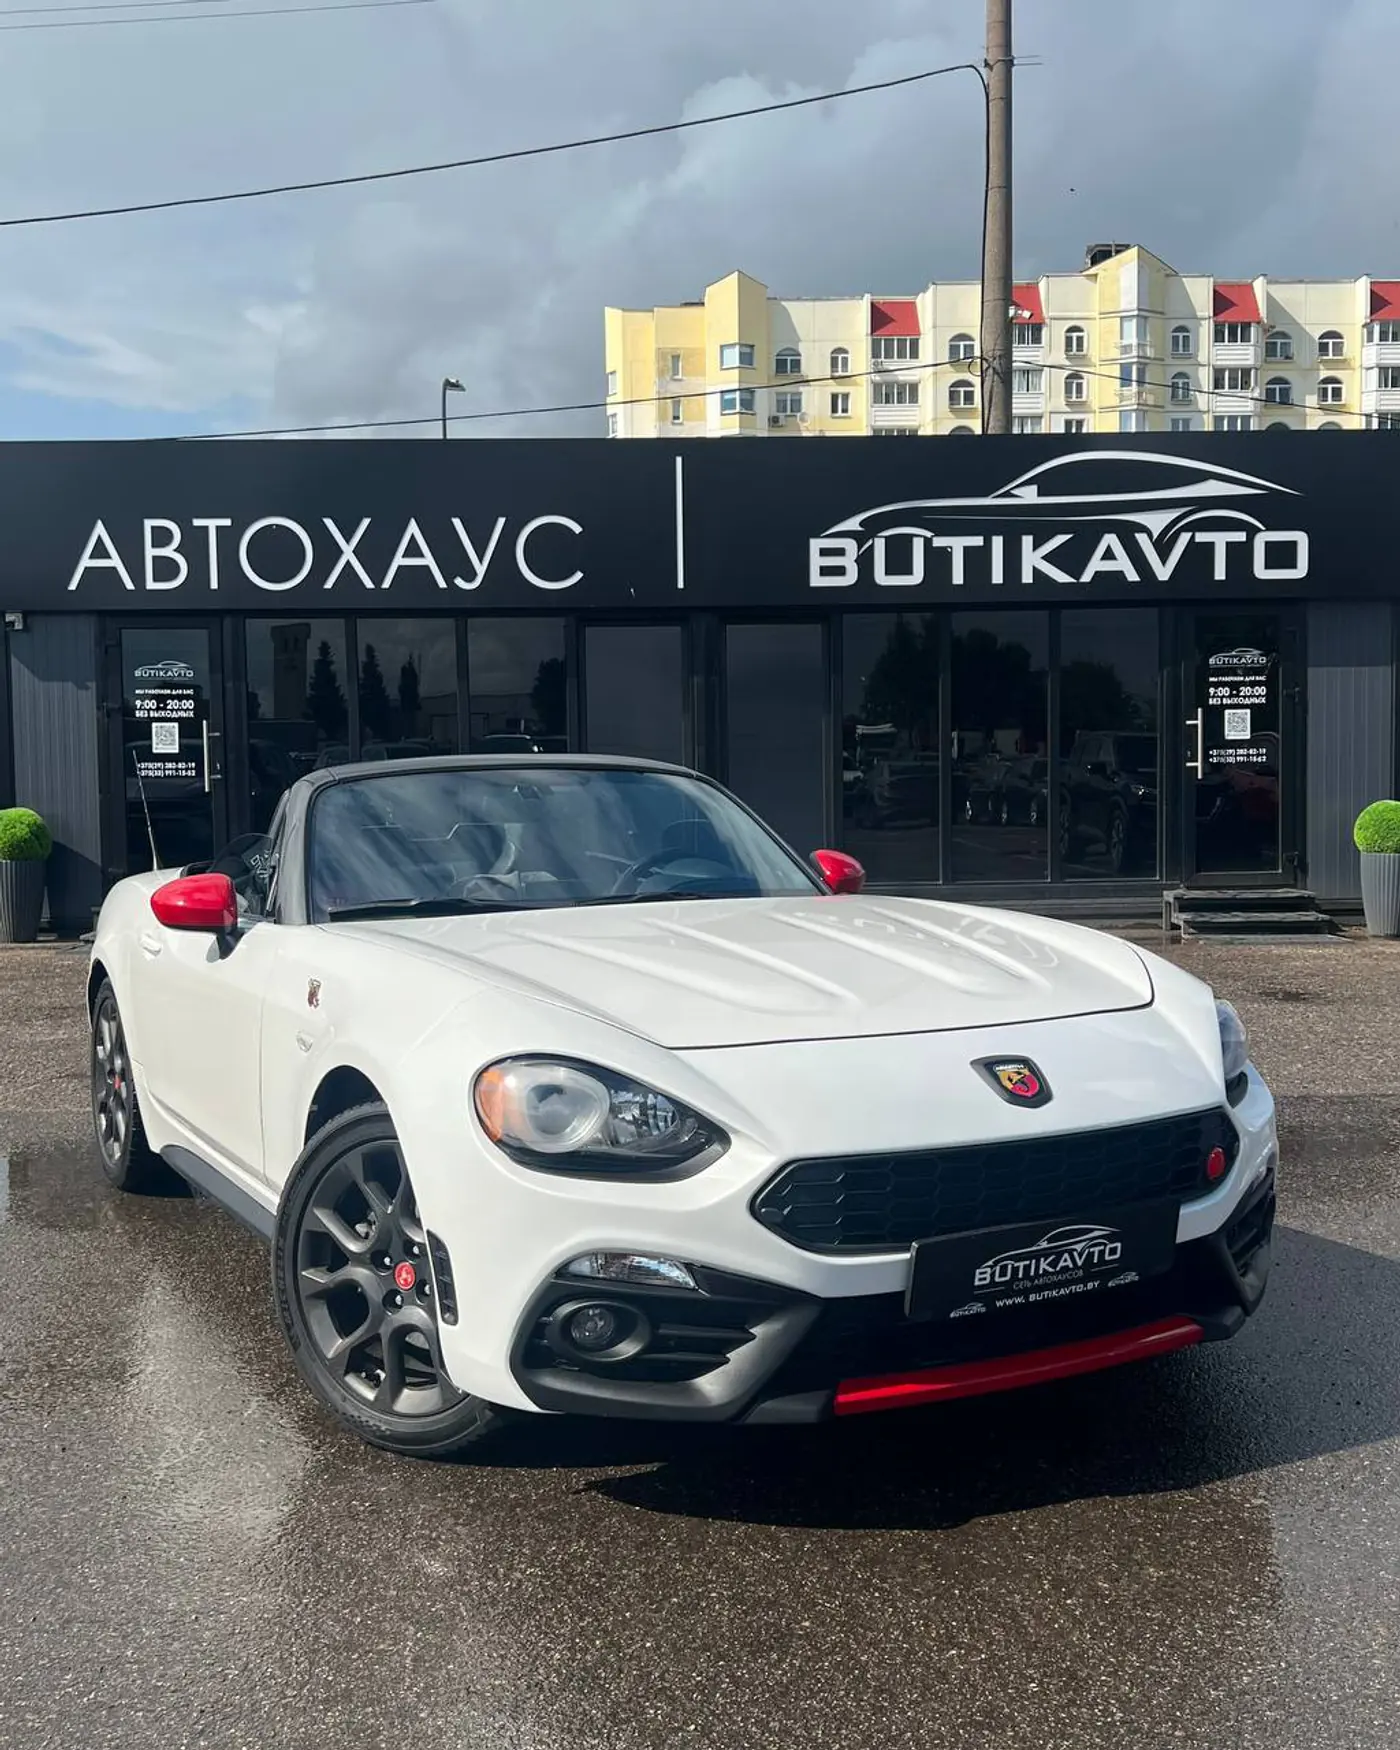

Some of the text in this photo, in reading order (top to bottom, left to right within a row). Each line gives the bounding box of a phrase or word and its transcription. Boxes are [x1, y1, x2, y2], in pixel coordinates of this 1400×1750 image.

[67, 515, 585, 591] АВТОХАУС
[808, 530, 1310, 588] BUTIKAVTO
[1209, 656, 1267, 665] BUTIKAVTO
[134, 669, 194, 678] BUTIKAVTO
[1209, 687, 1230, 696] 9:00
[1239, 686, 1267, 696] 20:00
[135, 699, 157, 709] 9:00
[166, 699, 194, 709] 20:00
[1209, 696, 1267, 705] БЕЗ ВЫХОДНЫХ
[135, 710, 194, 718] БЕЗ ВЫХОДНЫХ
[974, 1242, 1122, 1286] BUTIKAVTO
[1013, 1270, 1084, 1290] СЕТЬ АВТОХАУСОВ
